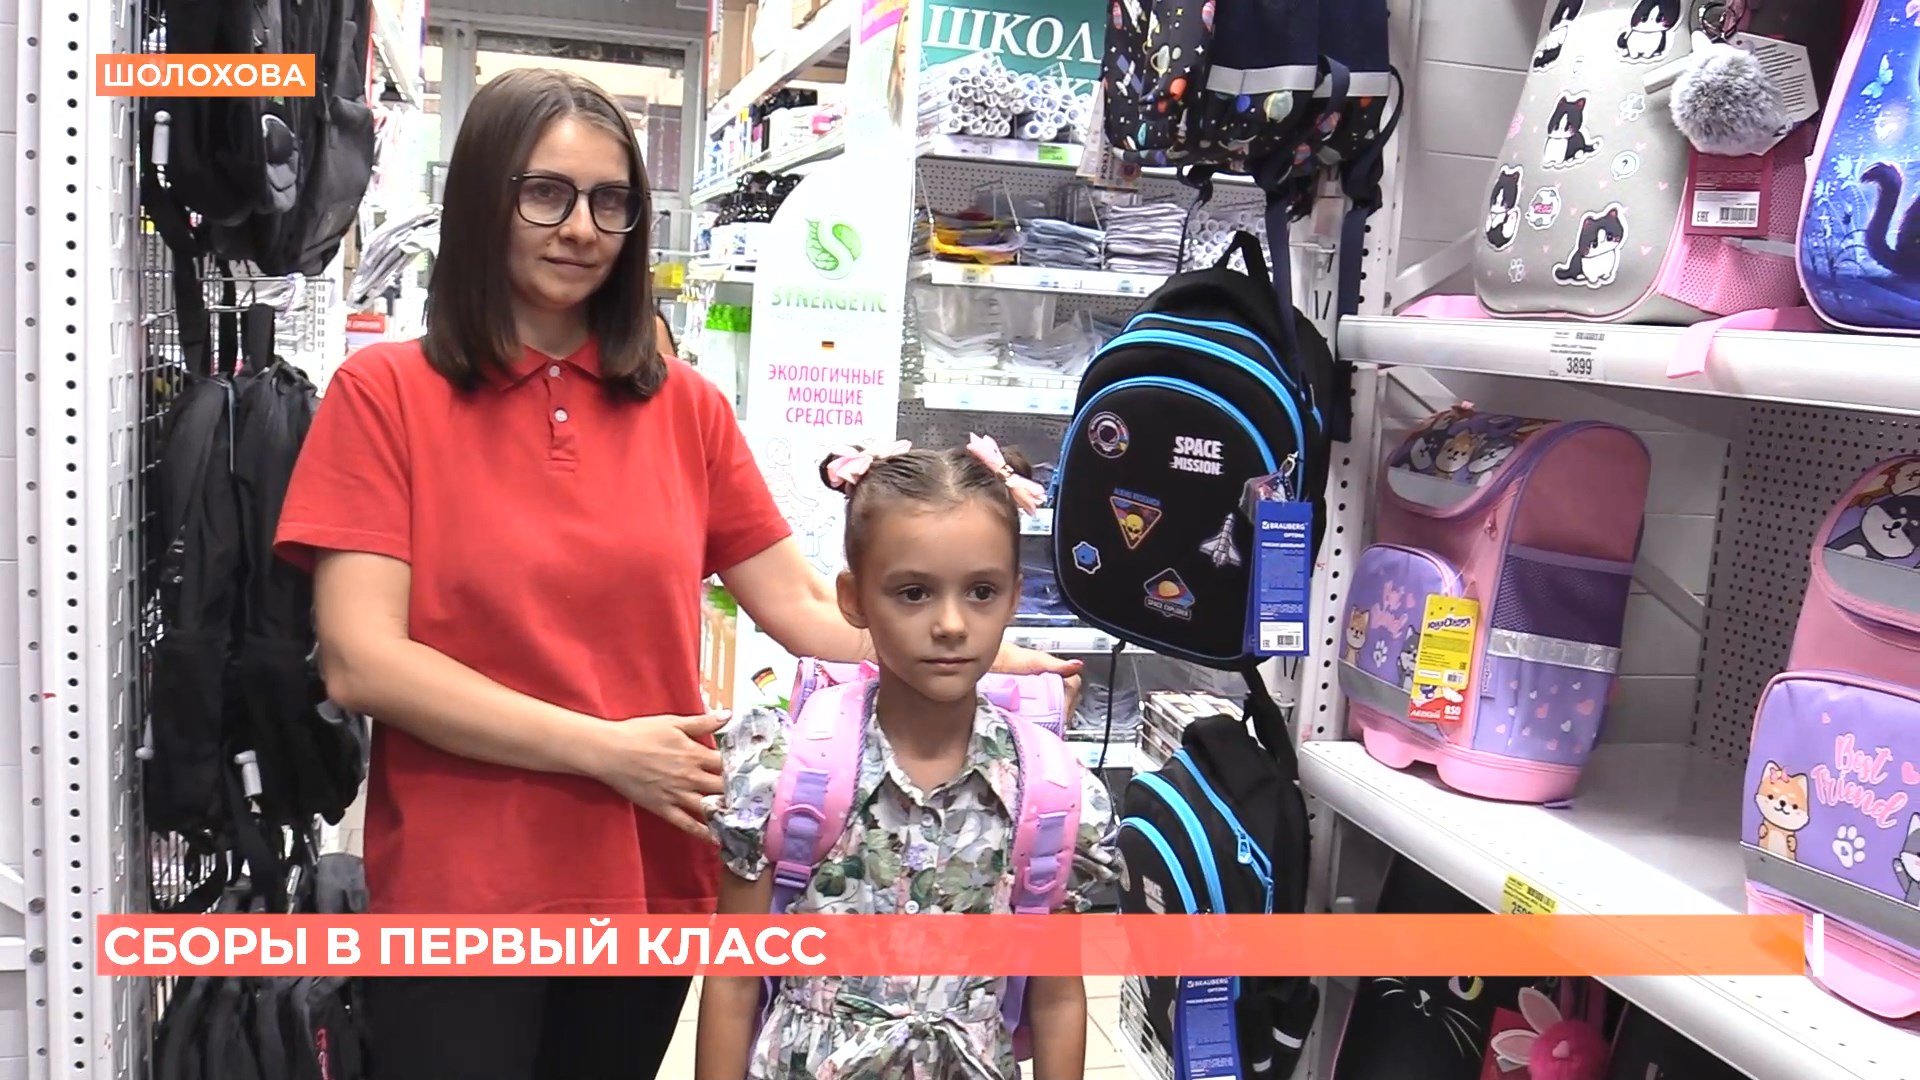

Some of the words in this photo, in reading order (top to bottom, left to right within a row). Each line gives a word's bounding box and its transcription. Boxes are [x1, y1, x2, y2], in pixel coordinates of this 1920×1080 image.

[768, 364, 885, 386] ЭКОЛОГИЧНЫЕ
[1566, 357, 1592, 375] 3899
[788, 386, 863, 407] МОЮЩИЕ
[785, 407, 864, 427] СРЕДСТВА
[1173, 435, 1224, 460] SPACE
[1169, 455, 1224, 475] MISSION
[1270, 522, 1305, 530] BRAUBERG
[1444, 704, 1461, 715] 850
[1835, 732, 1893, 785] Best
[1811, 764, 1908, 829] Friend
